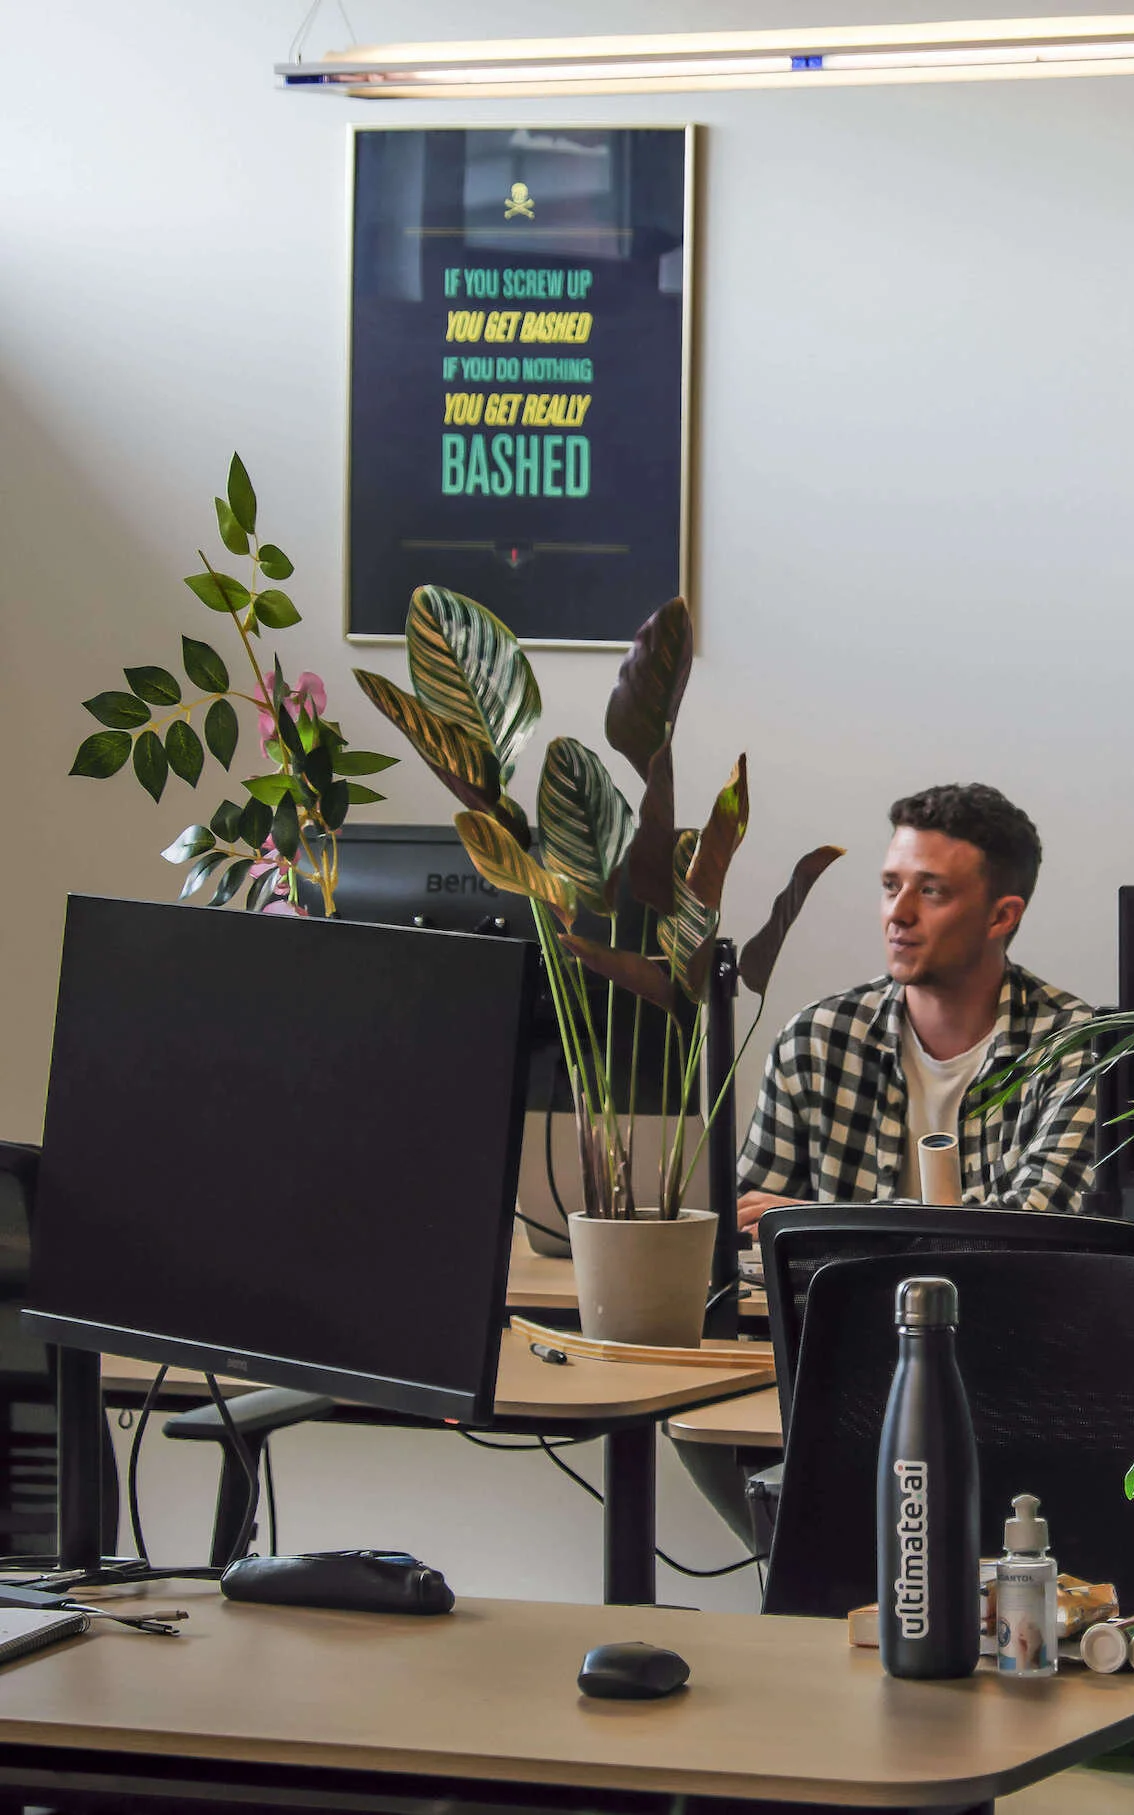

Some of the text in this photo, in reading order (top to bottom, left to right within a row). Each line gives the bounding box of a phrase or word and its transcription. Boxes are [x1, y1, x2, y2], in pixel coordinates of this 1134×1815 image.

[444, 268, 593, 299] IF YOU SCREW UP
[445, 310, 593, 344] YOU GET BASHED
[443, 356, 593, 383] IF YOU DO NOTHING
[443, 392, 592, 427] YOU GET REALLY
[441, 432, 592, 498] BASHED
[896, 1463, 925, 1634] ultimate.ai
